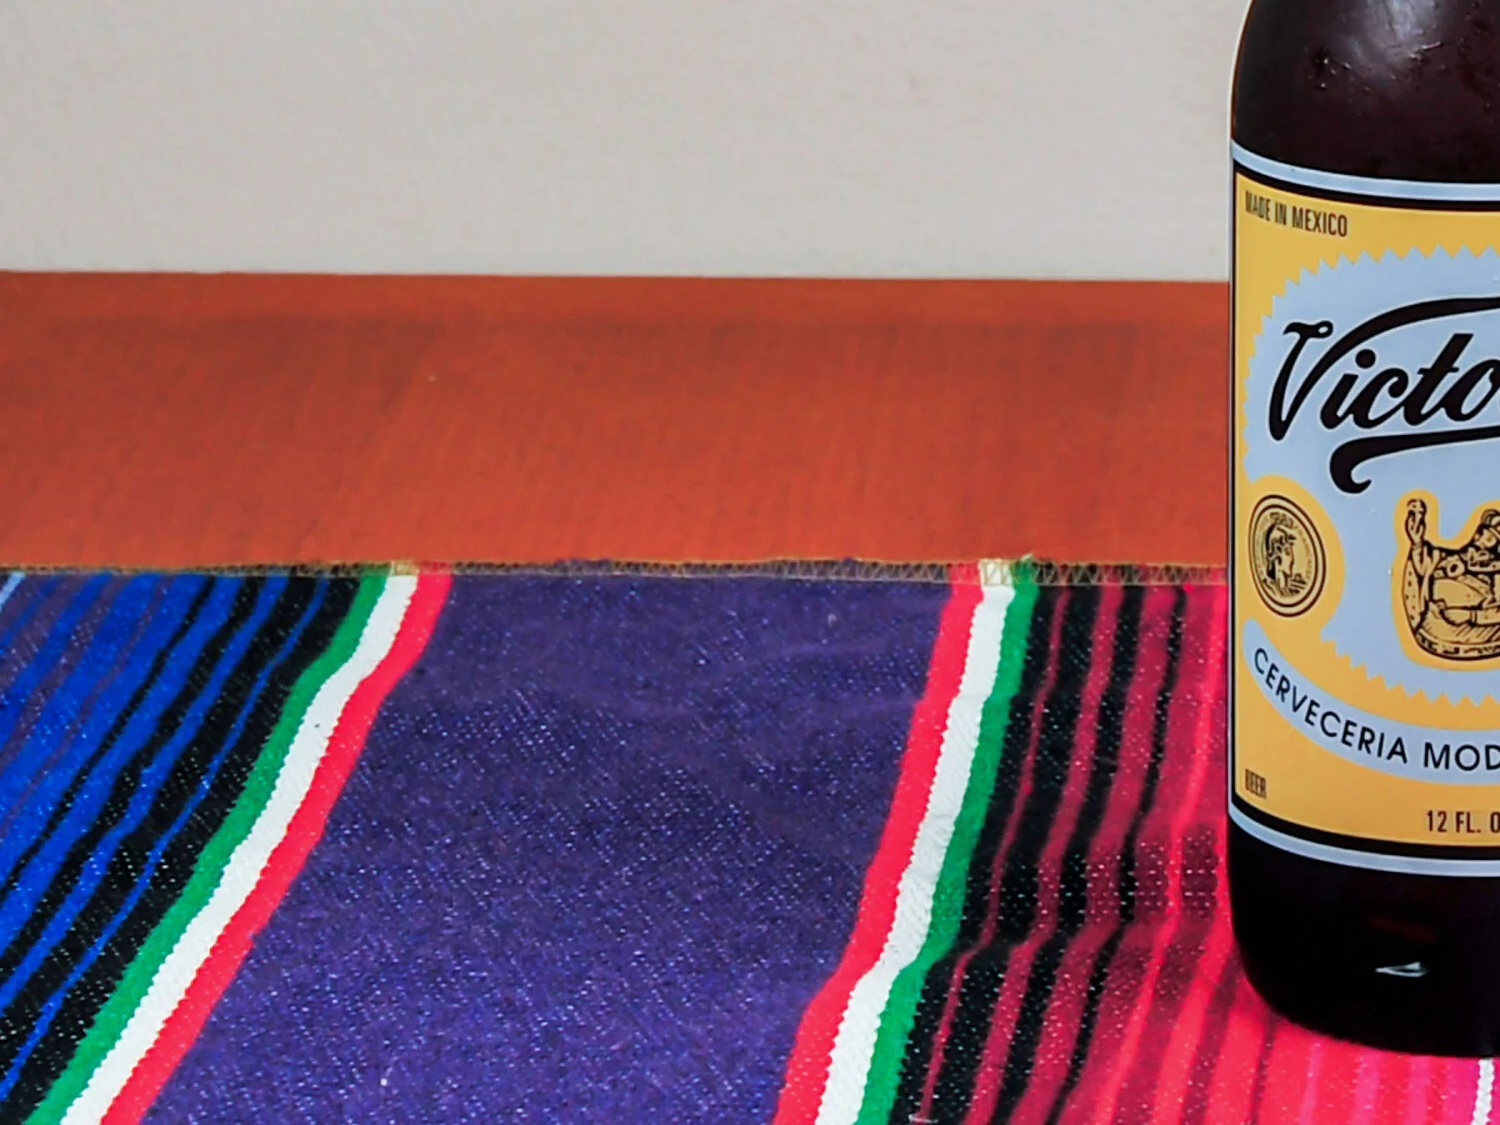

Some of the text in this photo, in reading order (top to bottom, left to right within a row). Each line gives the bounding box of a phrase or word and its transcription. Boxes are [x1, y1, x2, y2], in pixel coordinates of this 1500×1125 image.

[1245, 190, 1348, 238] MADE IN MEXICO
[1254, 647, 1408, 765] CERVECERIA
[1245, 768, 1267, 800] BEER
[1426, 809, 1447, 833] 12
[1455, 811, 1482, 834] FL.
